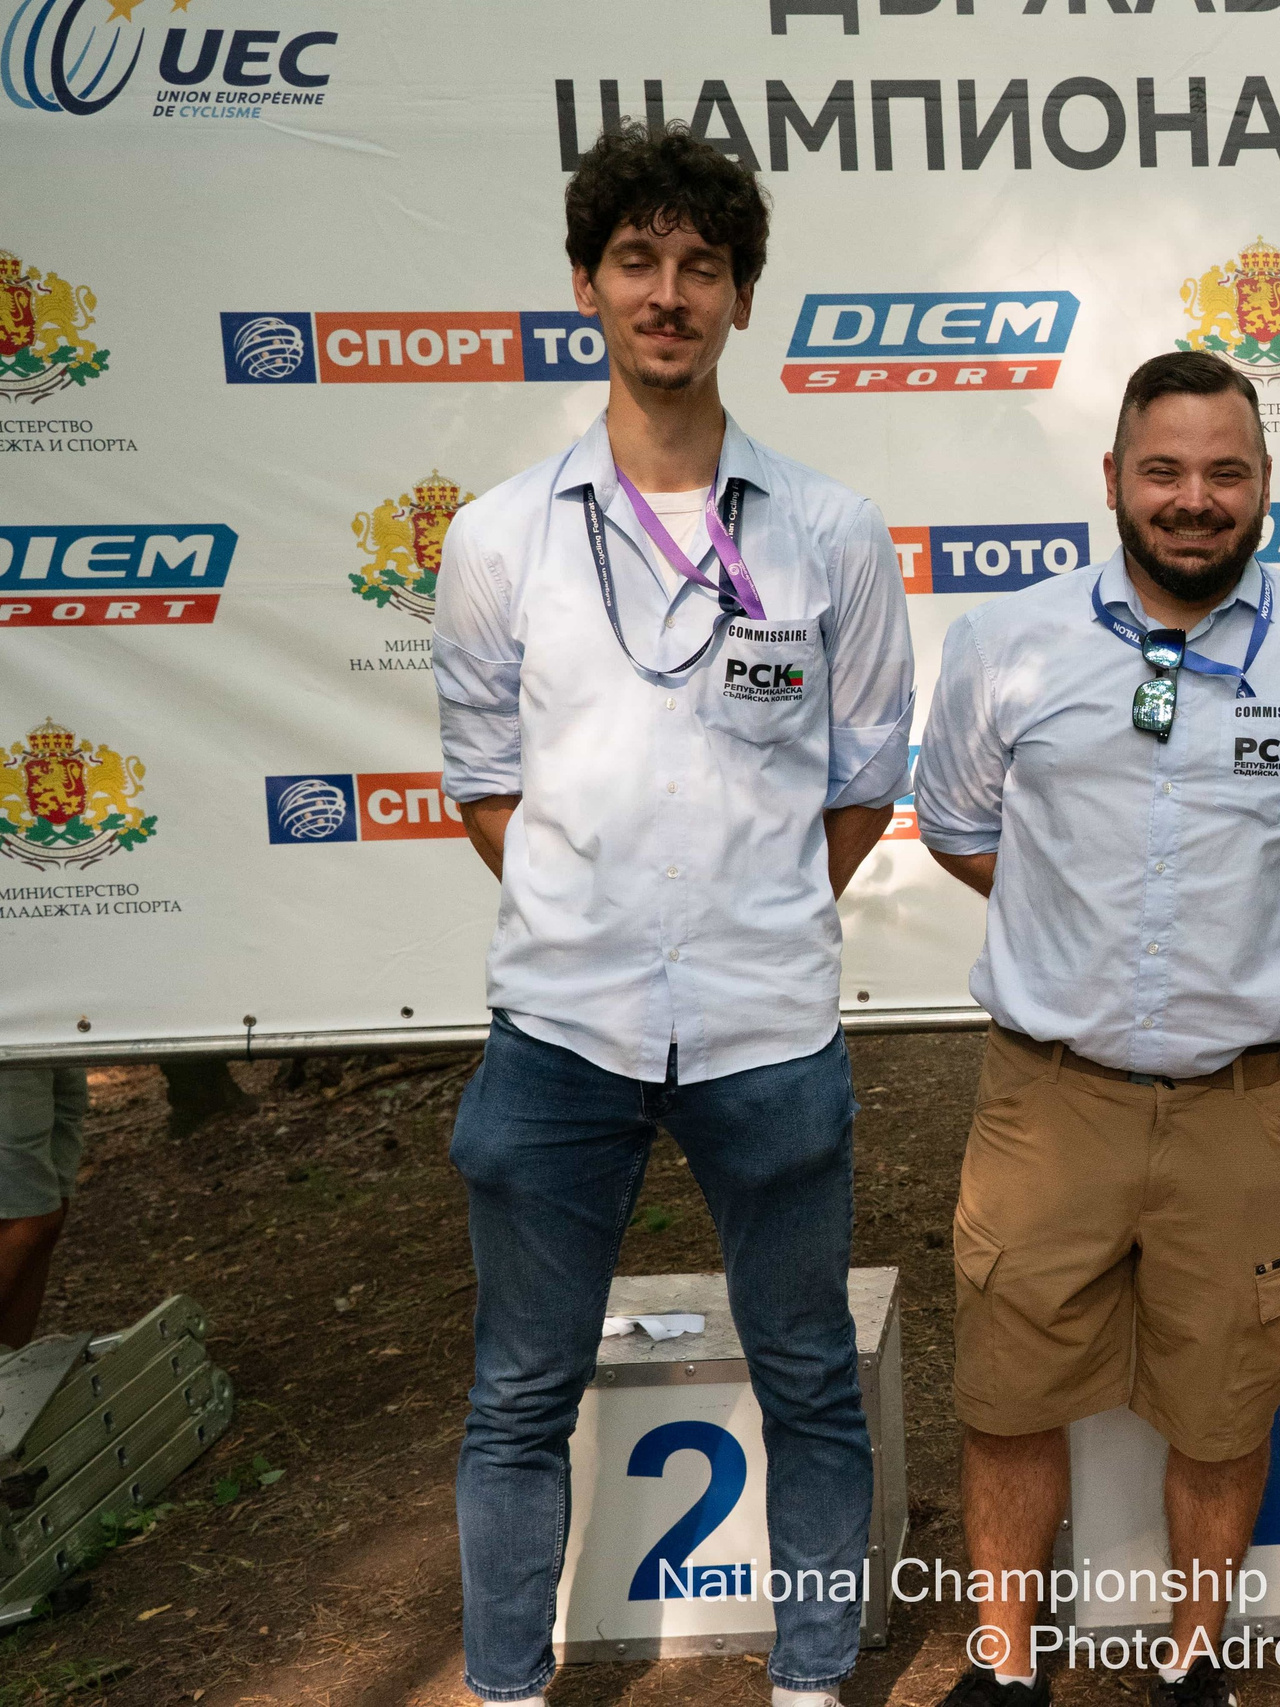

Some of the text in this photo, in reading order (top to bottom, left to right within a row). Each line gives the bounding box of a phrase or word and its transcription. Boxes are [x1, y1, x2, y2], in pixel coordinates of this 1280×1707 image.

[159, 28, 338, 88] UEC
[157, 90, 325, 105] UNION EUROPÉENNE
[153, 105, 262, 119] DE CYCLISME
[806, 300, 1059, 348] DIEM
[326, 328, 513, 366] СПОРТ
[803, 366, 1038, 389] SPORT
[50, 439, 63, 452] И
[67, 439, 138, 452] СПОРТА
[0, 534, 214, 579] IEM
[942, 538, 1079, 577] ТОТО
[728, 625, 807, 642] COMMISSAIRE
[350, 658, 375, 671] НА
[725, 658, 794, 688] РСК
[723, 691, 770, 703] СЪДИЙСКА
[724, 683, 803, 696] РЕПУБЛИКАНСКА
[1233, 769, 1279, 777] СЪДИЙСКА
[96, 903, 109, 915] И
[113, 900, 182, 914] СПОРТА
[627, 1421, 751, 1601] 2
